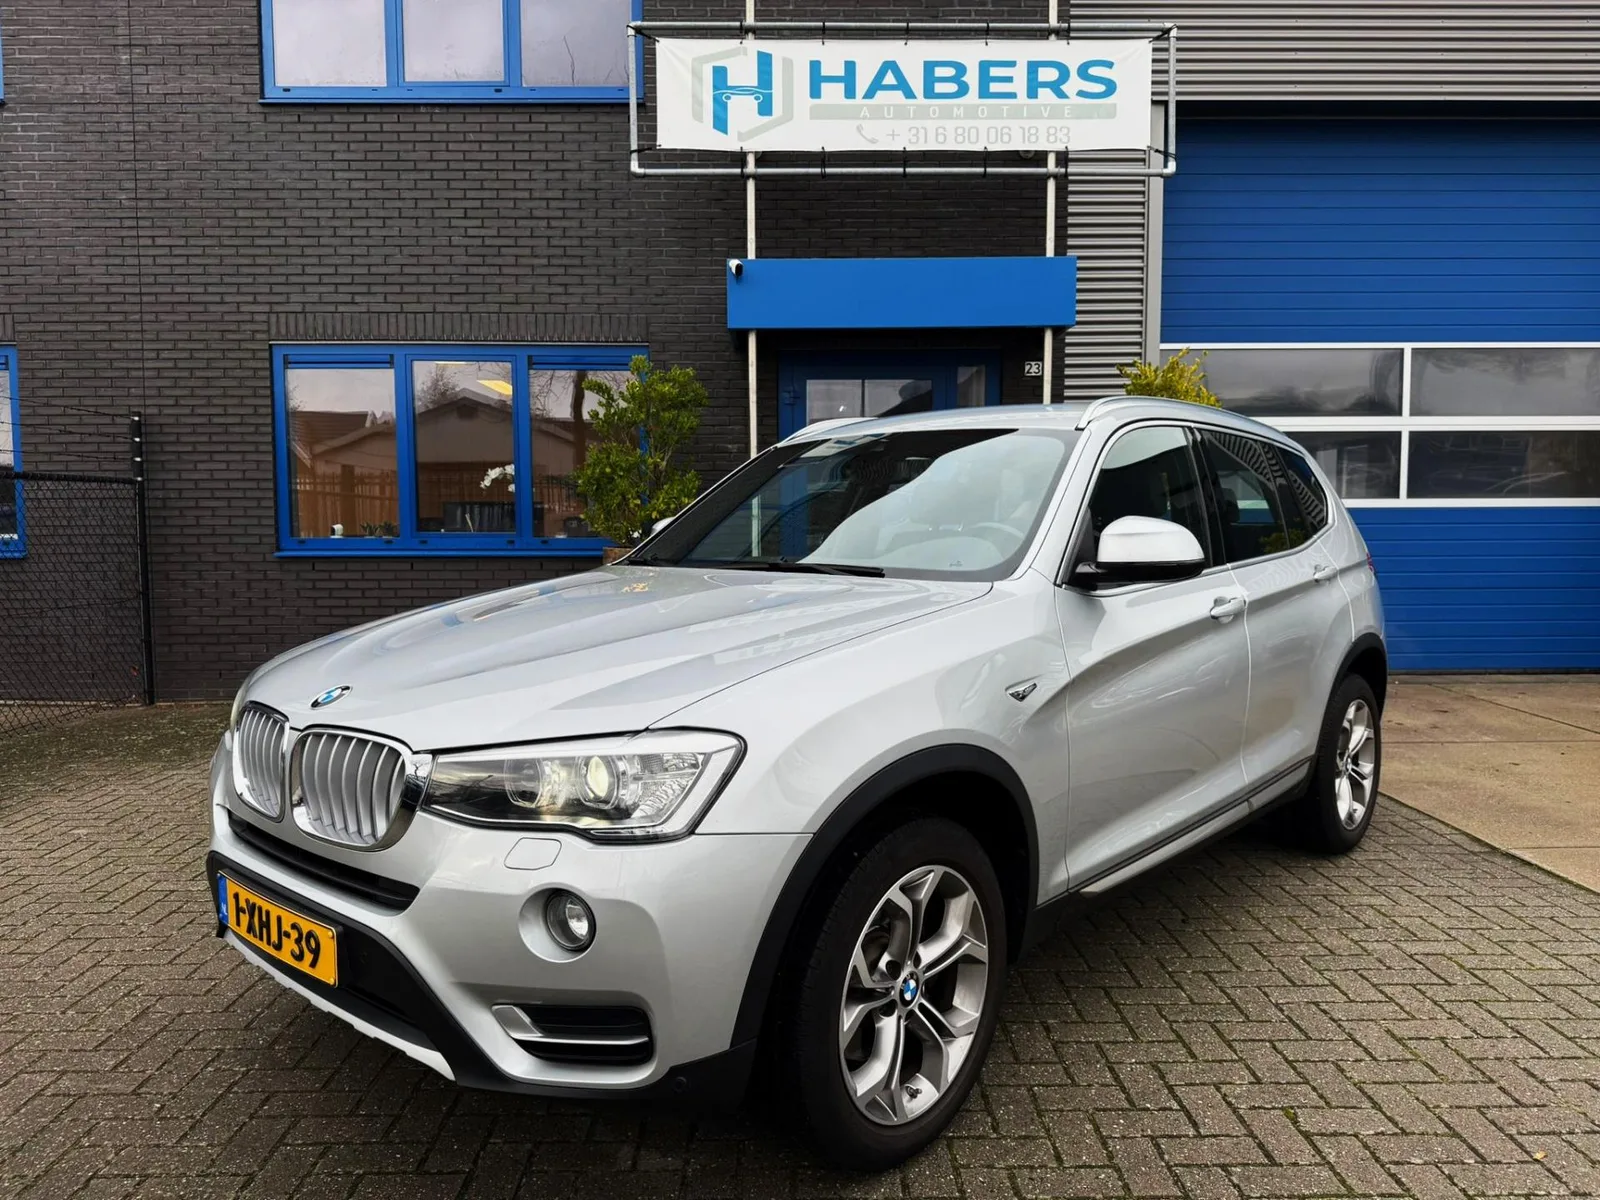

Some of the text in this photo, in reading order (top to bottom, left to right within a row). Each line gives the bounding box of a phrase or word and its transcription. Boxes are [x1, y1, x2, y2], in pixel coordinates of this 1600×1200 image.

[808, 59, 1118, 100] HABERS
[859, 105, 1073, 119] AUTOMOTIVE
[907, 126, 928, 145] 31
[934, 126, 948, 145] 6
[953, 126, 980, 145] 80
[986, 126, 1012, 145] 06
[1019, 126, 1040, 145] 18
[1046, 126, 1071, 145] 83
[1025, 362, 1042, 375] 23
[233, 891, 321, 969] 1-XHJ-39
